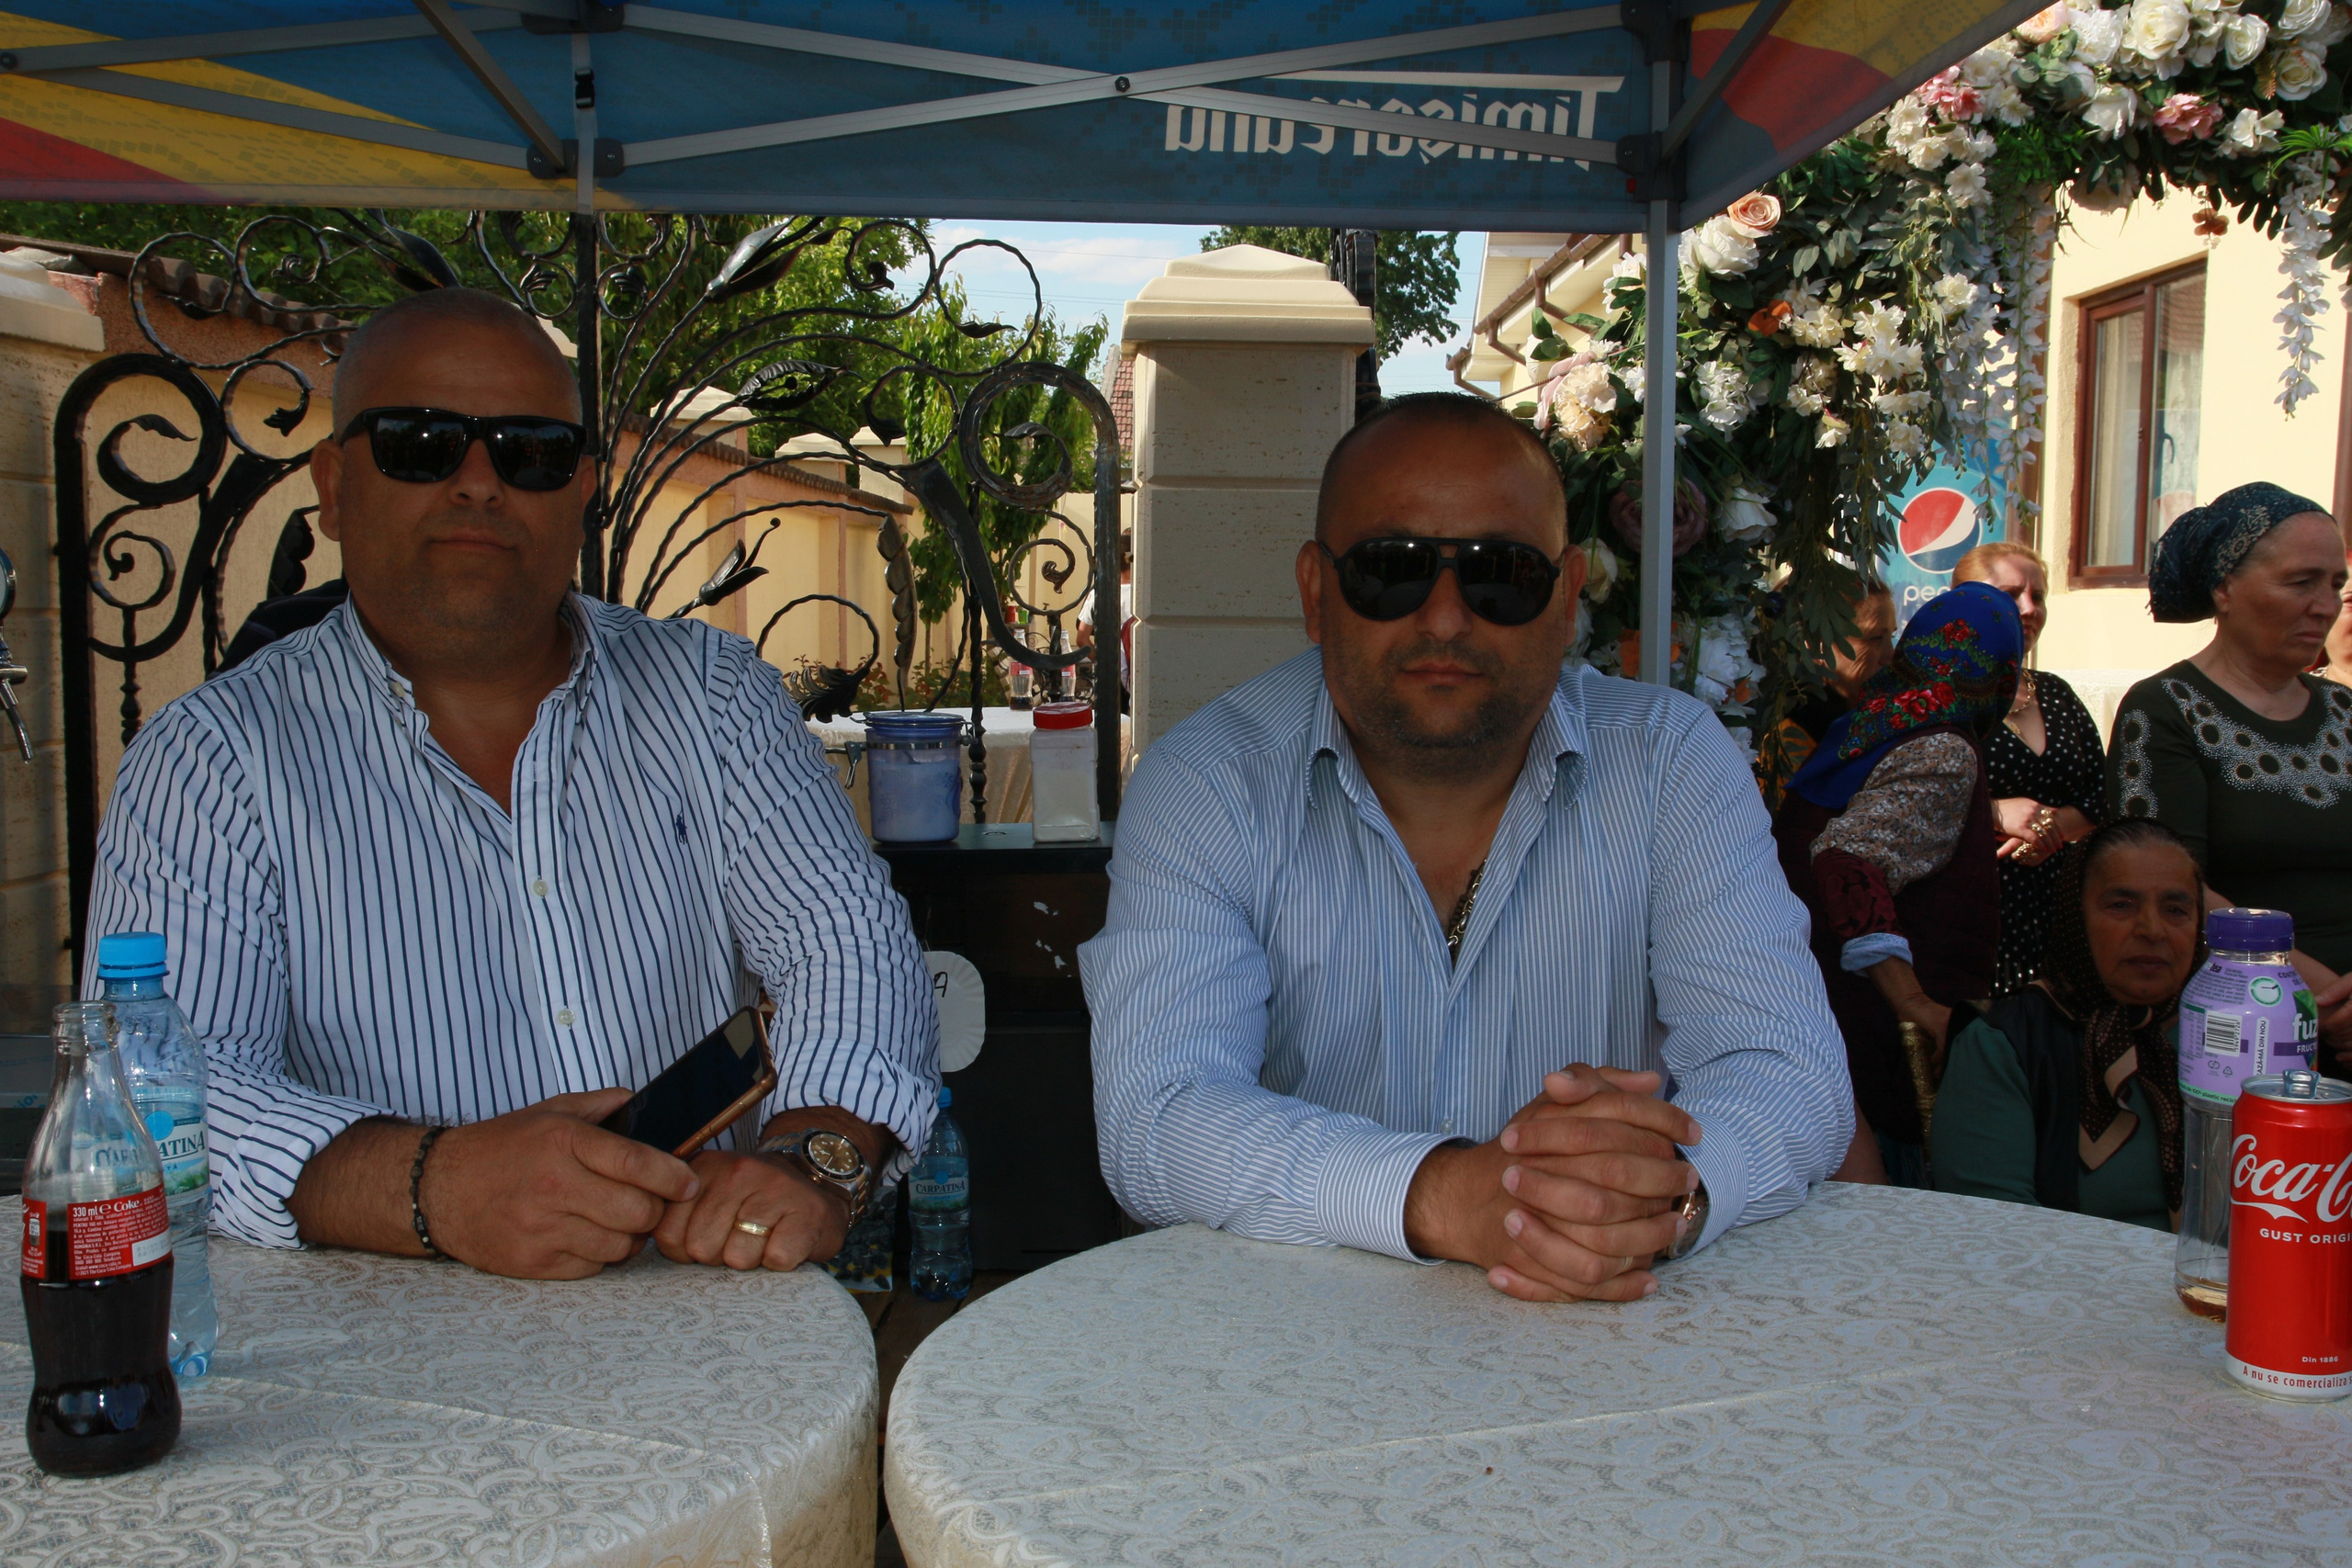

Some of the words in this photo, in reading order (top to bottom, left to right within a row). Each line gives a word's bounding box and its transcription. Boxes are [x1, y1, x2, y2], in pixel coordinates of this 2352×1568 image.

[2202, 1091, 2220, 1100] plastic
[916, 1179, 966, 1194] CARPATINA
[73, 1206, 86, 1217] 330
[88, 1205, 97, 1216] ml
[114, 1200, 140, 1213] Coke
[2259, 1228, 2303, 1243] GUST
[2310, 1233, 2352, 1244] ORIGI
[2243, 1365, 2248, 1376] A
[2251, 1370, 2263, 1381] nu
[2267, 1374, 2278, 1384] se
[2283, 1377, 2347, 1389] comercializa
